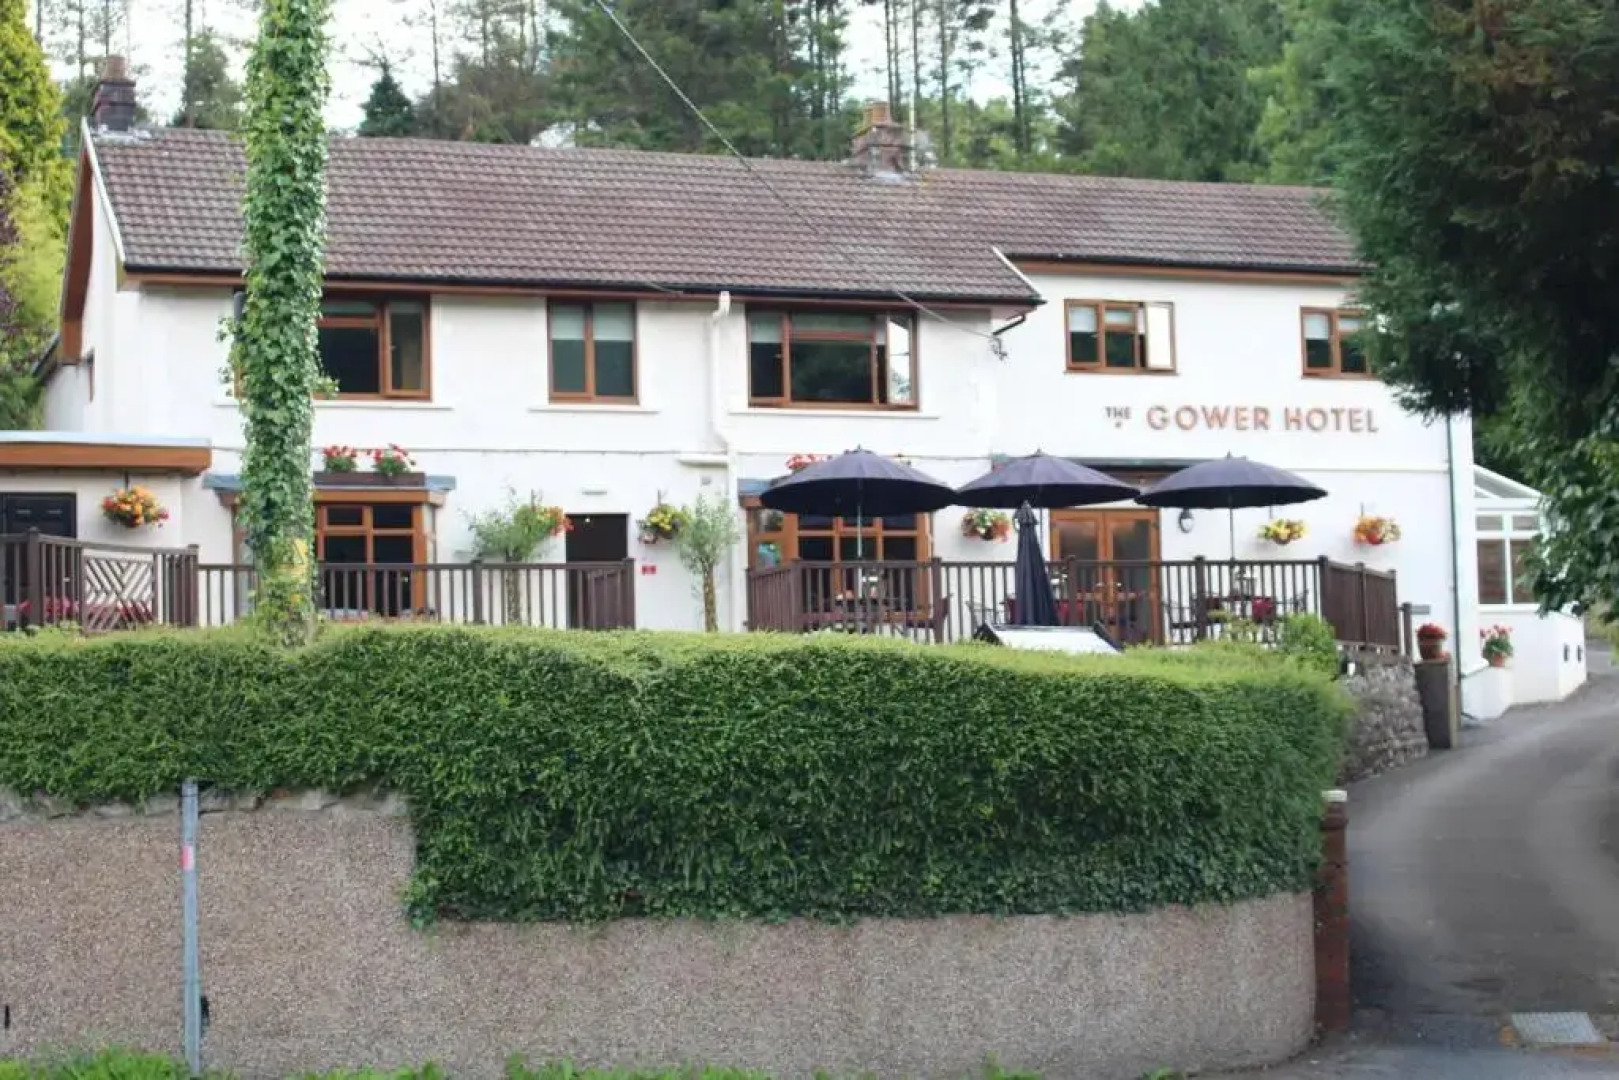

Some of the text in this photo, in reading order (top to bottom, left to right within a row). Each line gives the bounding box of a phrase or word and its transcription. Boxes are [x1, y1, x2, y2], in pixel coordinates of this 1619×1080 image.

[1105, 404, 1379, 433] THE GOWER HOTEL
